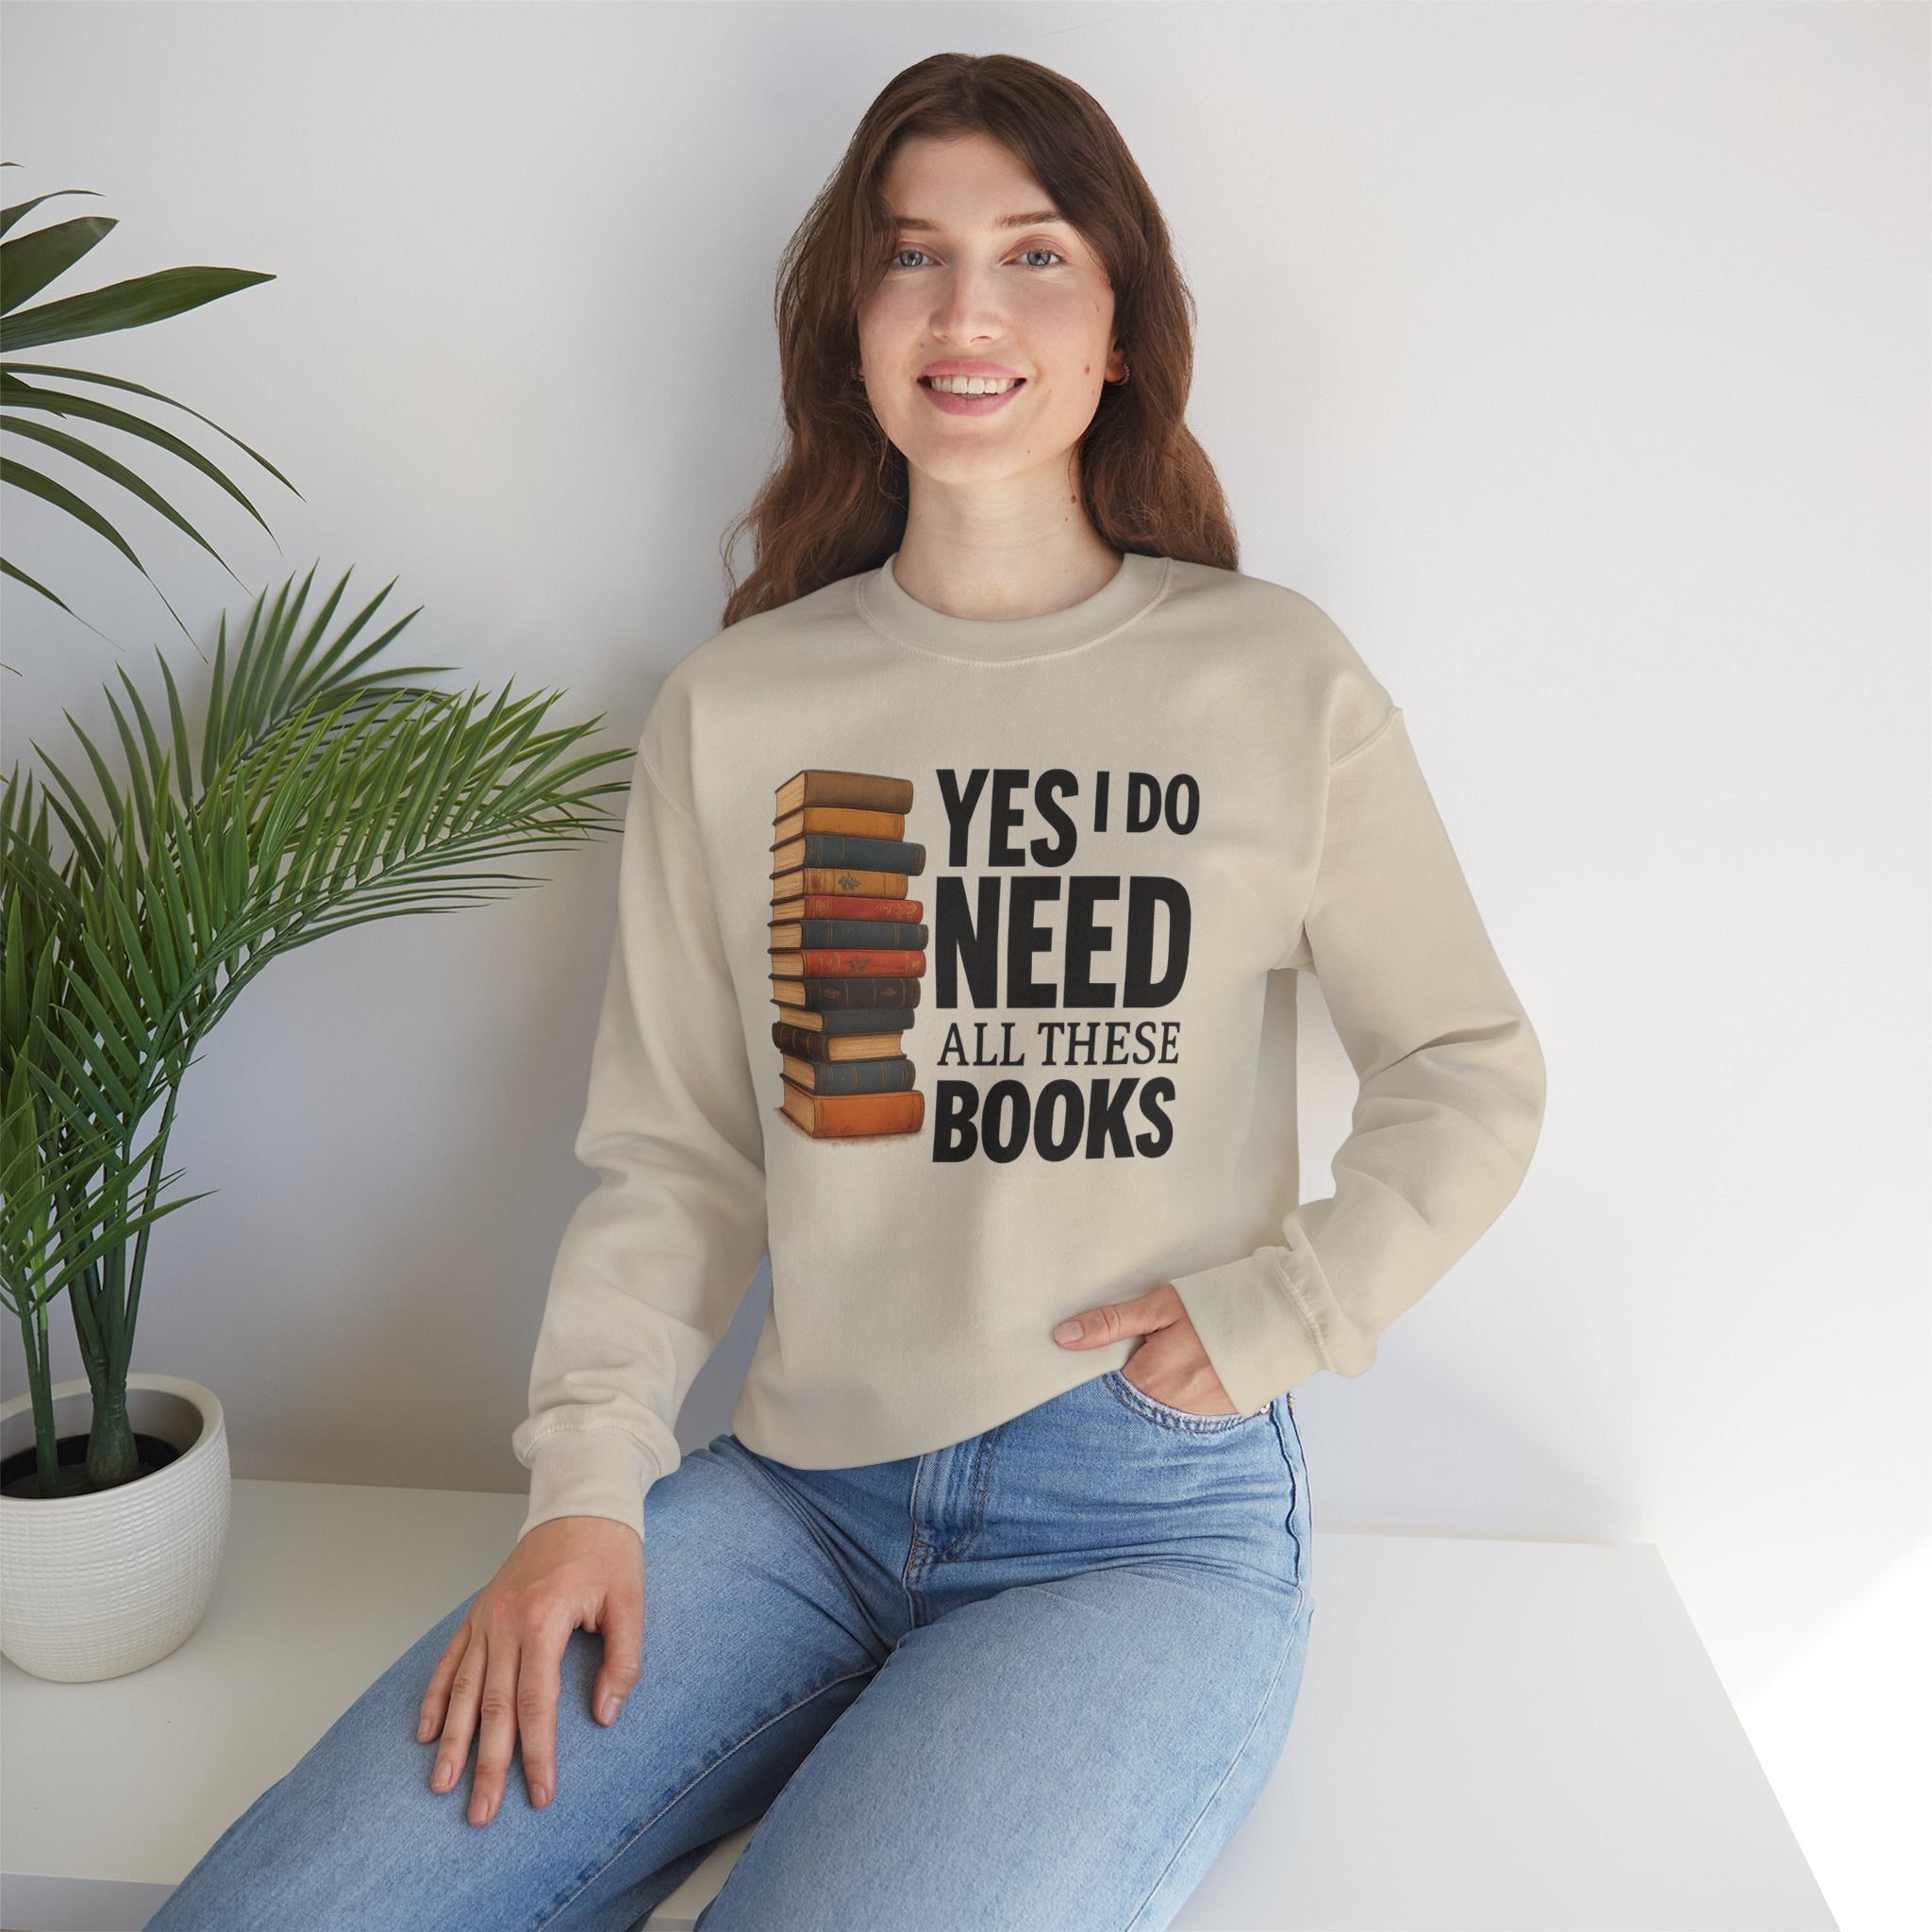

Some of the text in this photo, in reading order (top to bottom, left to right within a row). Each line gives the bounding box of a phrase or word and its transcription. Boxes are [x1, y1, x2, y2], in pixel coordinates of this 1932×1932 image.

[936, 769, 1200, 867] YES I DO
[935, 875, 1191, 1009] NEED
[937, 1022, 1180, 1066] ALL THESE
[932, 1076, 1176, 1164] BOOKS
